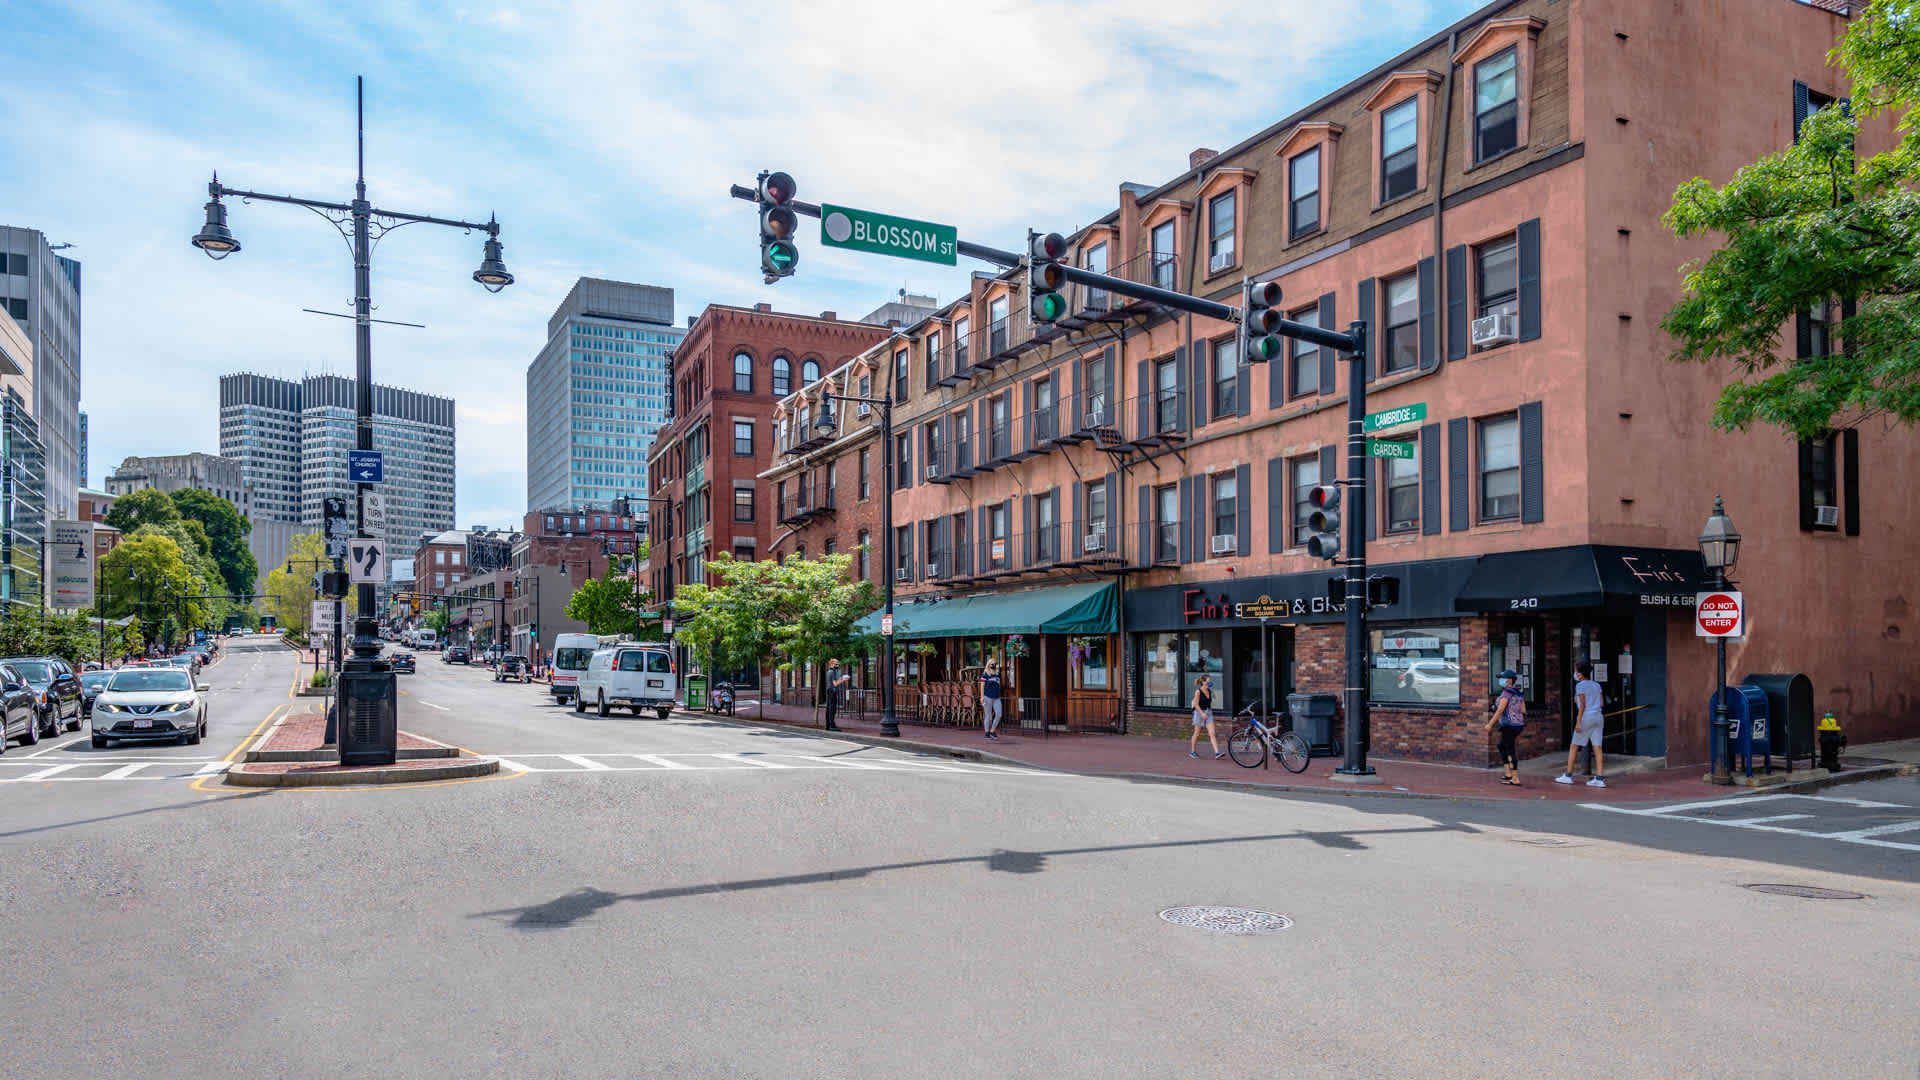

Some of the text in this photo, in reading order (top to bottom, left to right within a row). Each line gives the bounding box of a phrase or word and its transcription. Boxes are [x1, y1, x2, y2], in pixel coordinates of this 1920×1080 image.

[854, 220, 953, 255] BLOSSOM ST
[1375, 408, 1410, 426] CAMBRIDGE
[1374, 443, 1402, 456] GARDEN
[370, 496, 378, 506] NO
[368, 508, 383, 518] TURN
[365, 519, 384, 529] ON RED
[1622, 556, 1685, 583] Fin's
[1511, 598, 1537, 608] 240
[1640, 595, 1670, 605] SUSHI
[1672, 596, 1680, 605] &
[1184, 590, 1229, 624] Fin's
[1293, 598, 1306, 614] &
